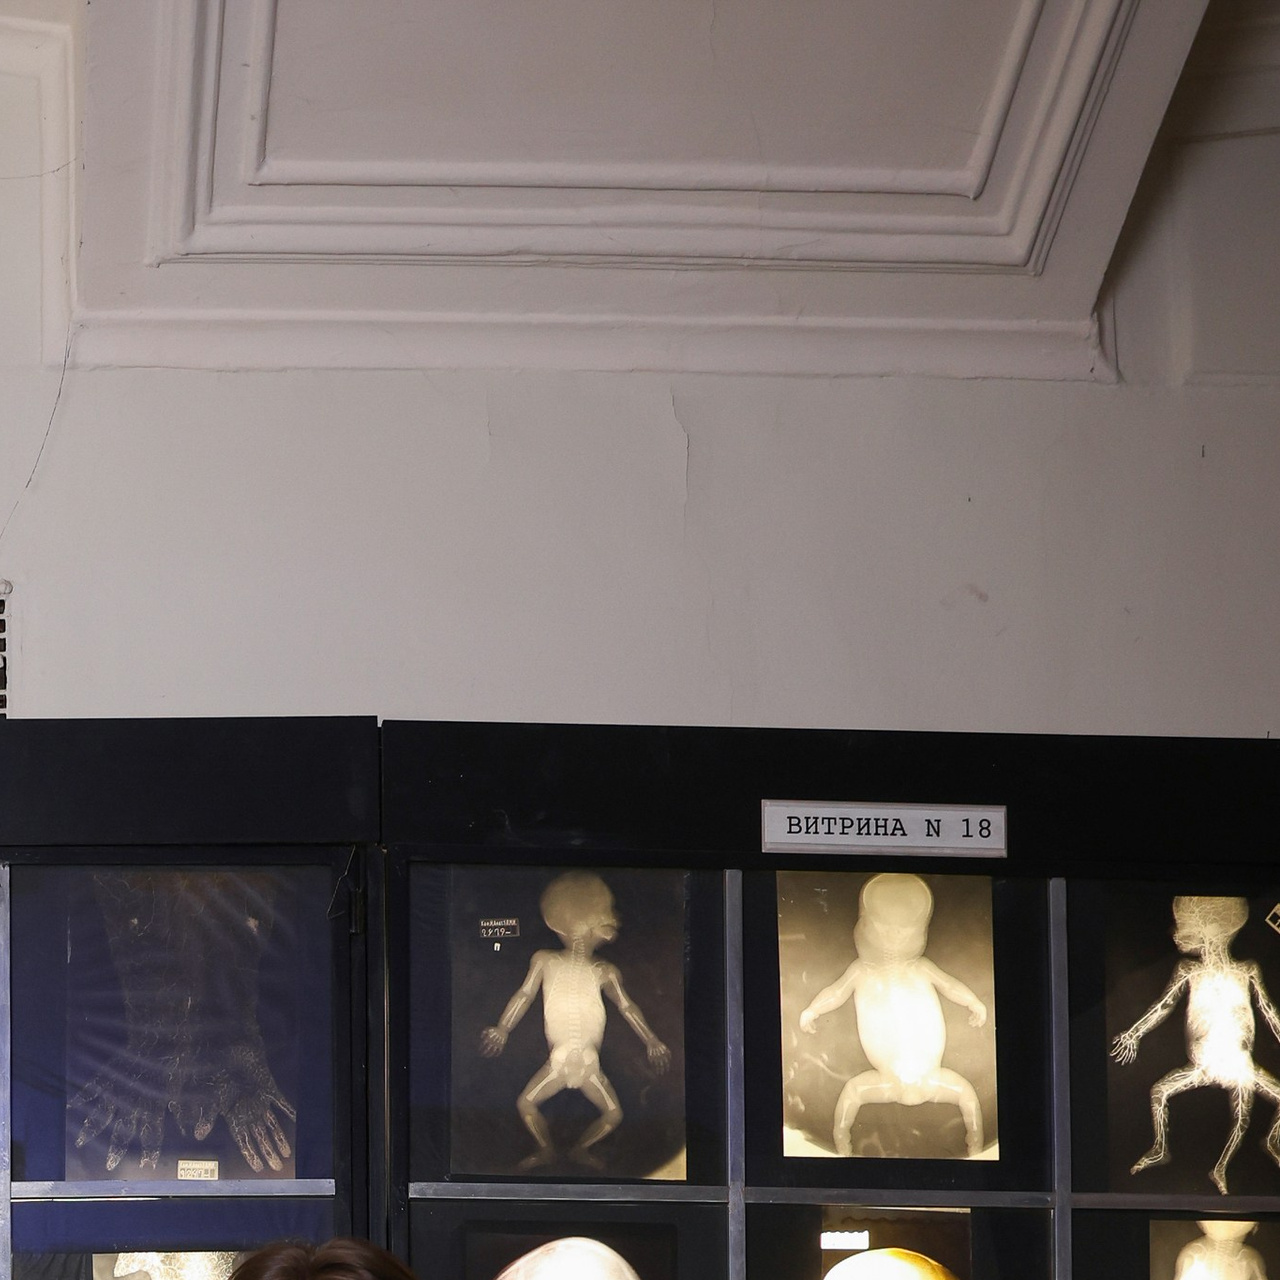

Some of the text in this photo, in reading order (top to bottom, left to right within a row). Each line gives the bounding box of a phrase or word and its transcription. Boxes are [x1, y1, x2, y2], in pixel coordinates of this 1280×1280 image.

[786, 816, 992, 838] ВИТРИНА N 18
